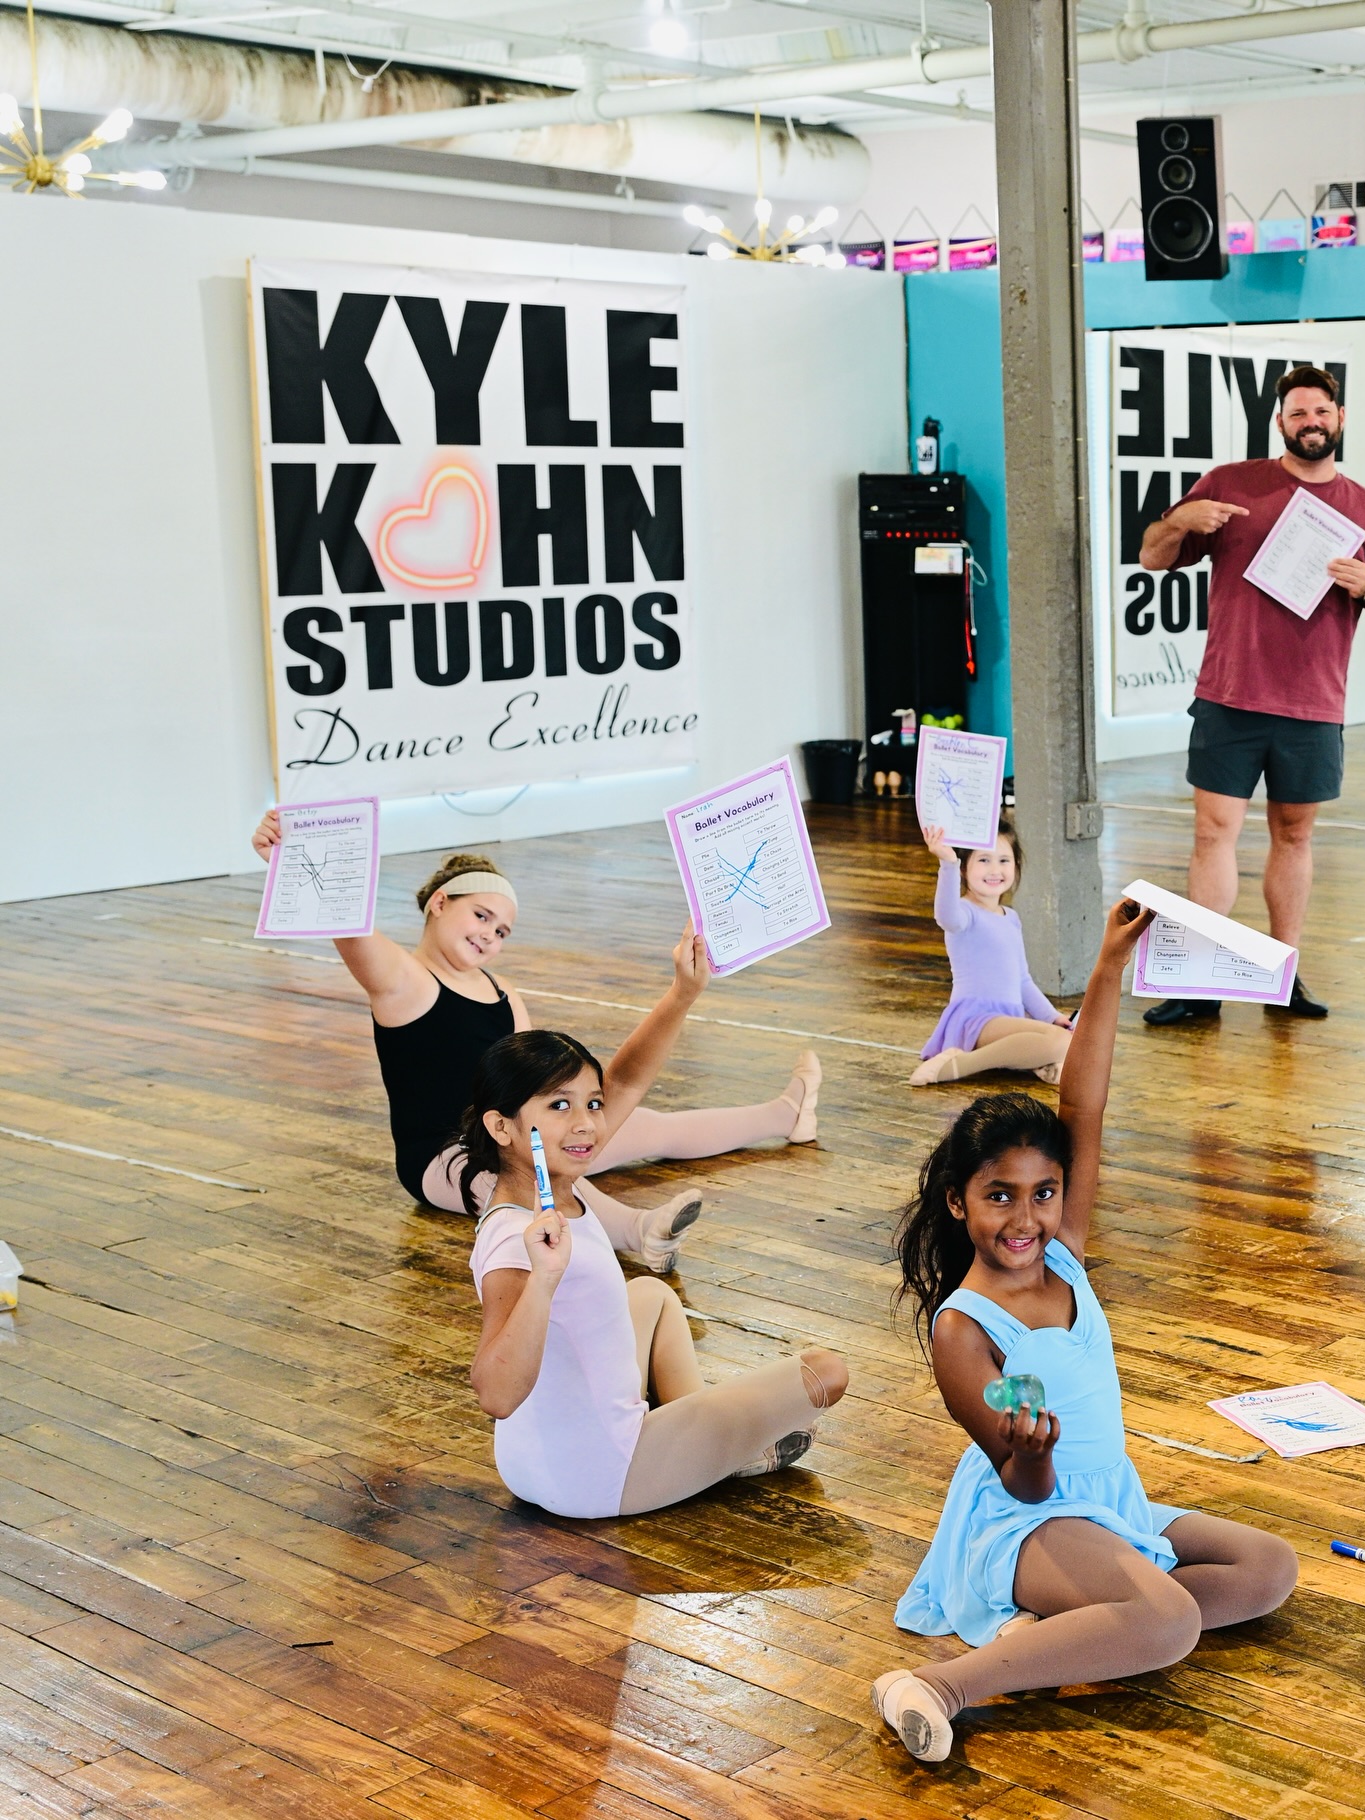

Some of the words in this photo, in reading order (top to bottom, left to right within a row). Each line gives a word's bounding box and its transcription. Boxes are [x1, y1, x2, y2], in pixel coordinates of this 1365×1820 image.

[262, 287, 684, 448] KYLE
[270, 462, 685, 597] KHN
[282, 591, 681, 696] STUDIOS
[285, 705, 464, 771] Dance
[488, 683, 699, 752] Excellence
[293, 821, 315, 829] Ballet
[318, 817, 360, 826] Vocabulary
[695, 814, 722, 832] Ballet
[724, 792, 774, 818] Vocabulary
[1157, 951, 1187, 959] Changement
